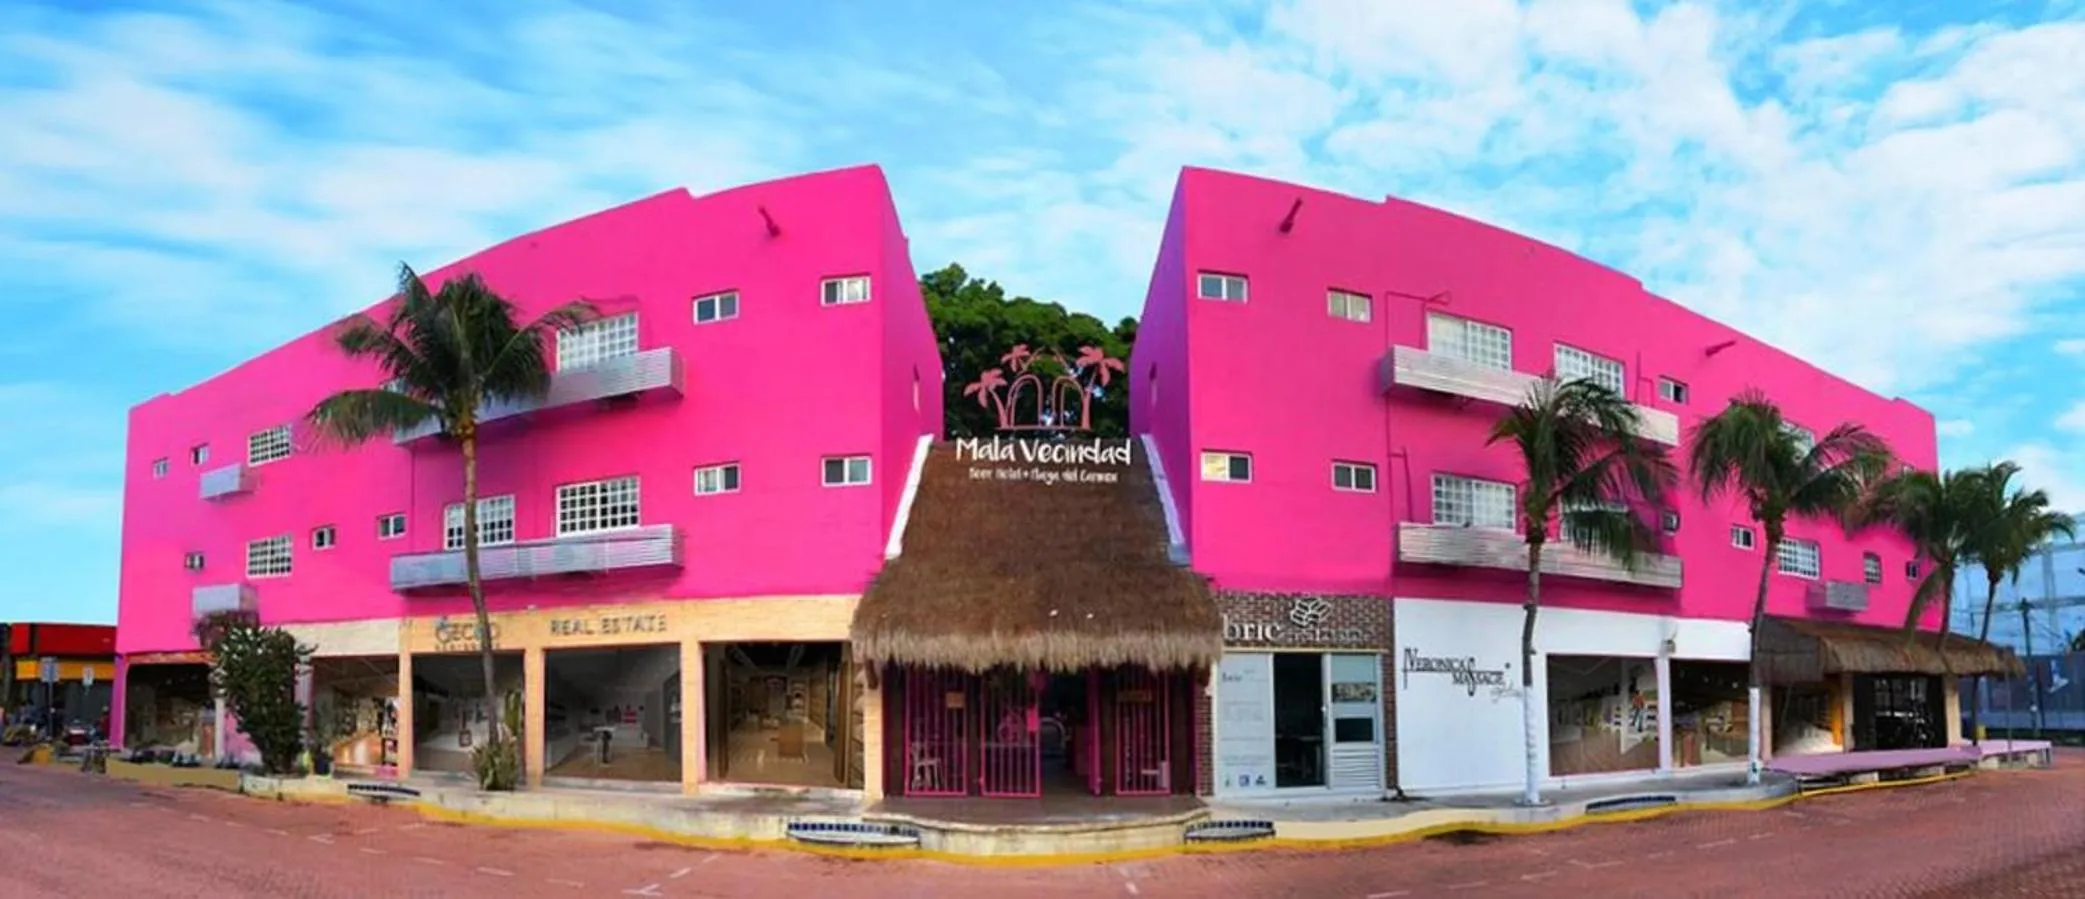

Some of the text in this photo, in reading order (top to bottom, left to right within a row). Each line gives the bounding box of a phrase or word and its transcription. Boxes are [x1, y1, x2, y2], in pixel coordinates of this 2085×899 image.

[955, 435, 1132, 466] Mala Vecindad
[434, 617, 501, 643] GECO
[550, 614, 667, 636] REAL ESTATE
[1222, 613, 1281, 642] bric
